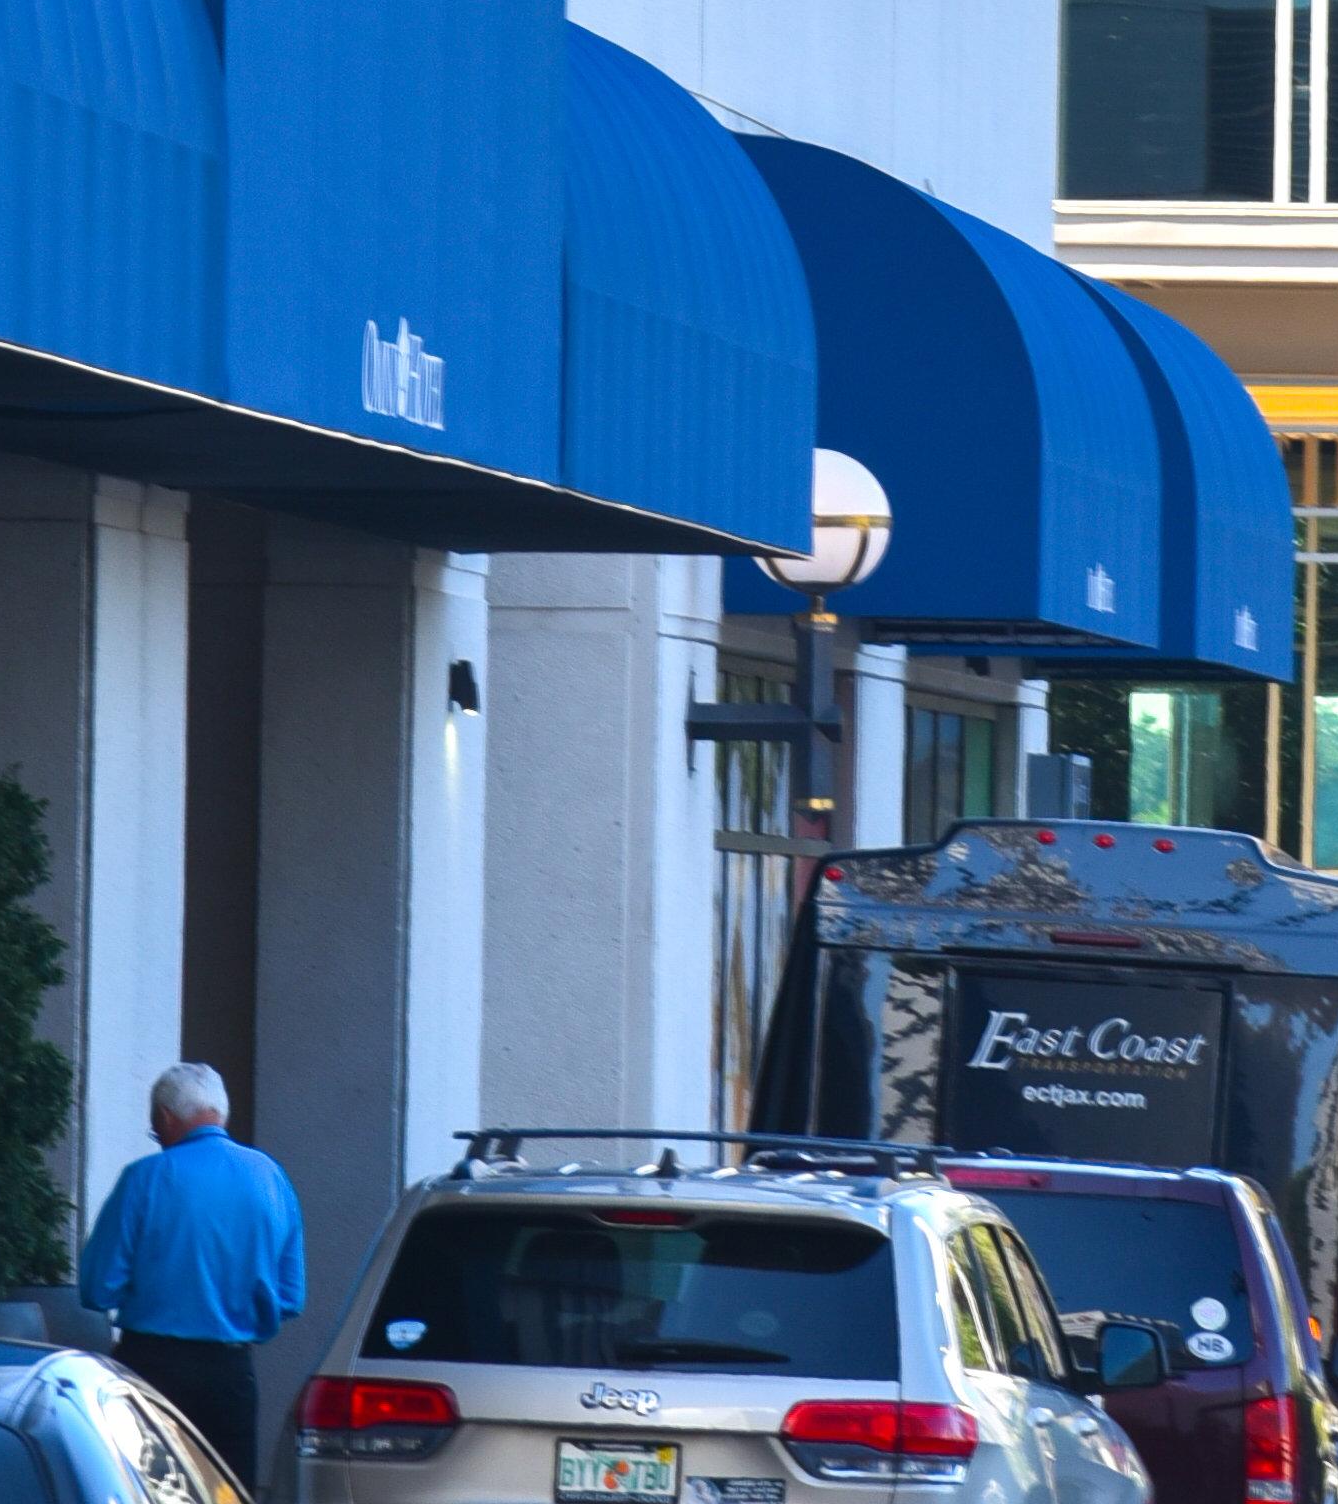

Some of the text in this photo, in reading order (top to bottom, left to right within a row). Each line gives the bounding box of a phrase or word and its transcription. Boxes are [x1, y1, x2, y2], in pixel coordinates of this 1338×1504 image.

[965, 1009, 1211, 1071] East Coast
[1021, 1082, 1148, 1110] ectjax.com
[579, 1381, 661, 1417] Jeep
